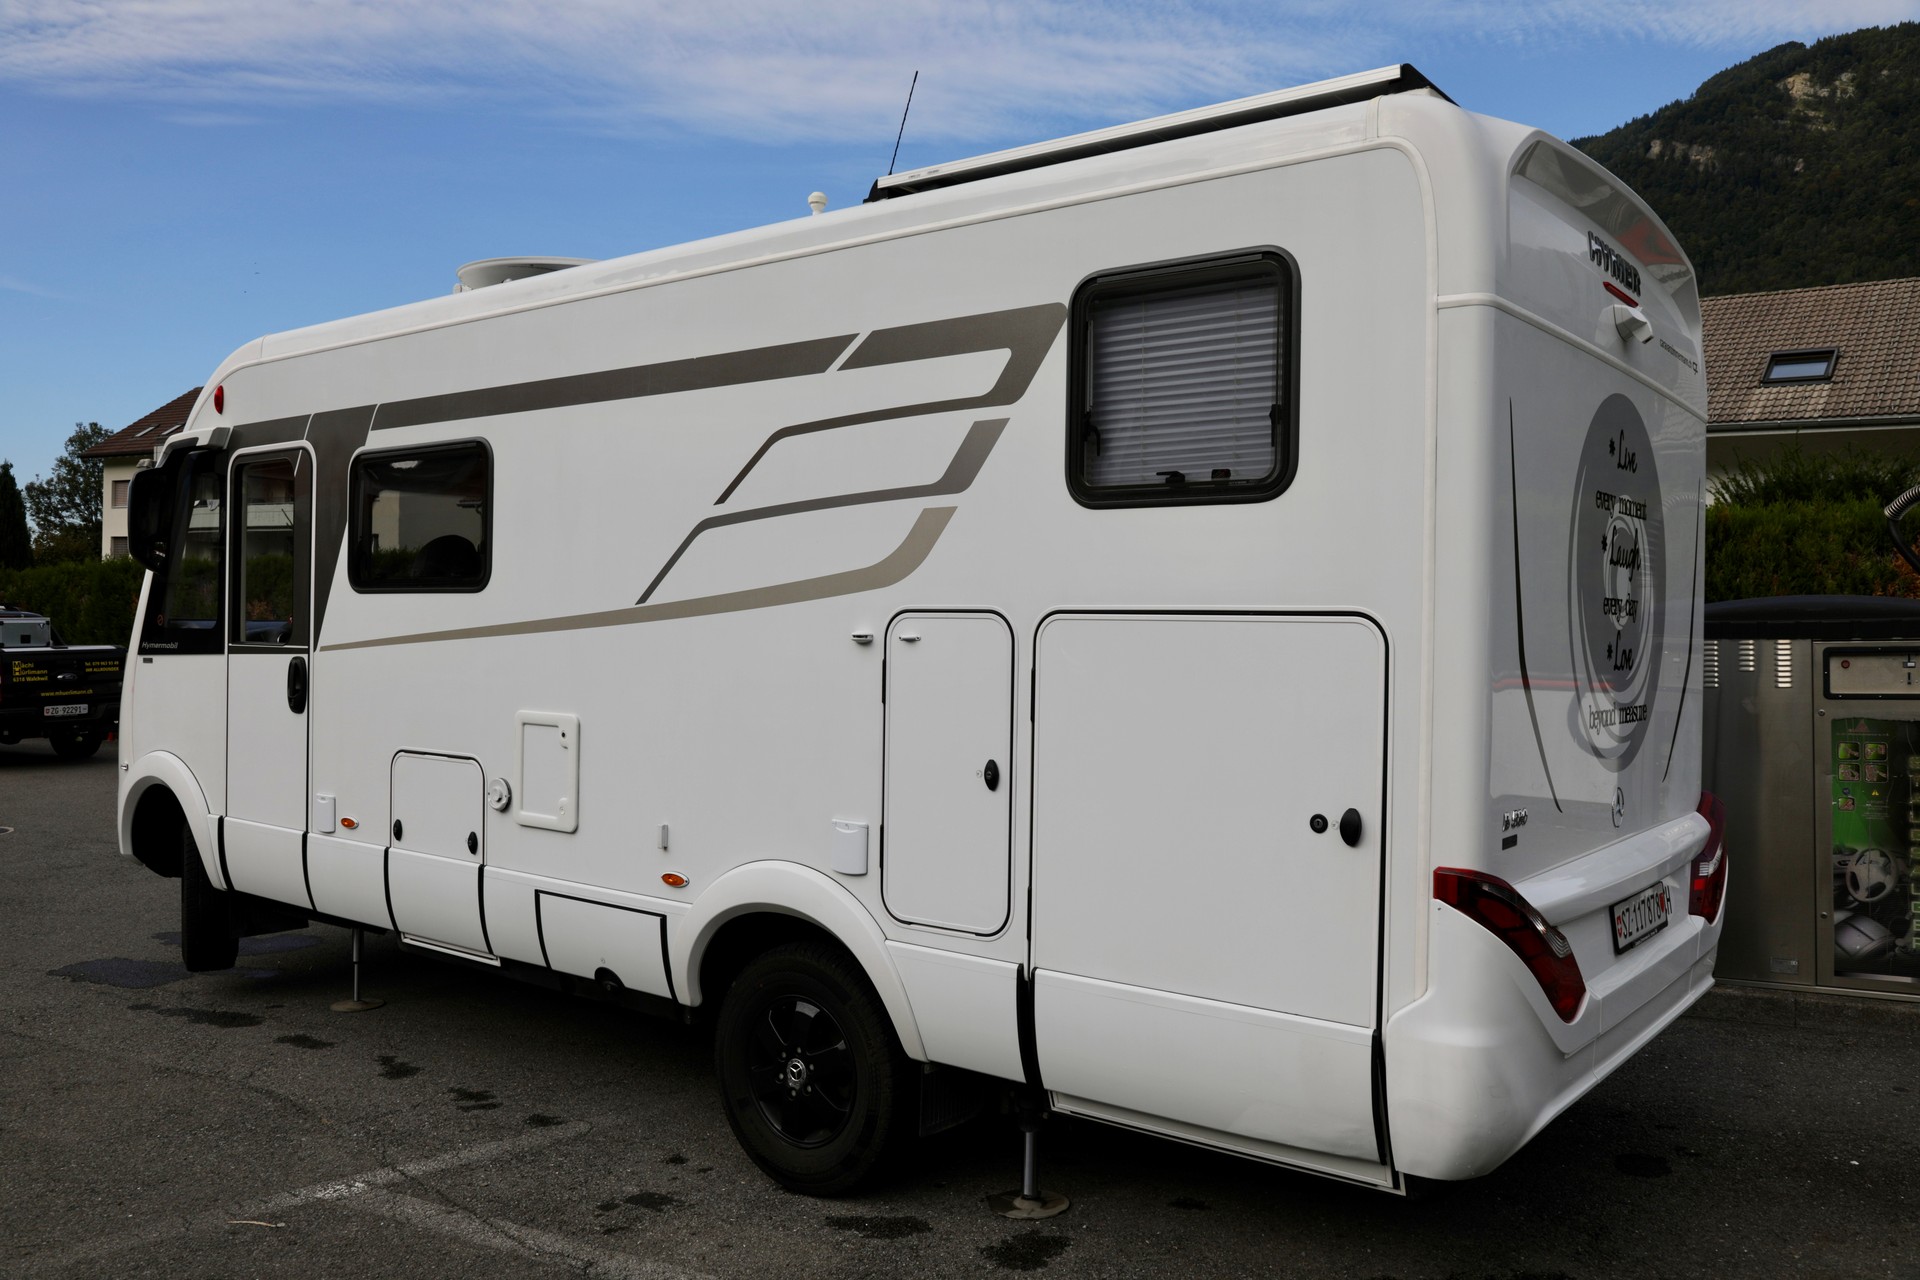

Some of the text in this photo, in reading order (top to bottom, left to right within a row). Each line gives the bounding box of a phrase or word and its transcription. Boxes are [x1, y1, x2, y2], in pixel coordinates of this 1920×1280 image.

[1617, 429, 1638, 474] Live
[1596, 490, 1647, 520] every moment
[1609, 525, 1641, 583] Laugh
[1603, 593, 1639, 624] every day
[141, 641, 179, 650] Hymermobil
[1613, 630, 1634, 671] Love
[1589, 701, 1648, 736] beyond measure
